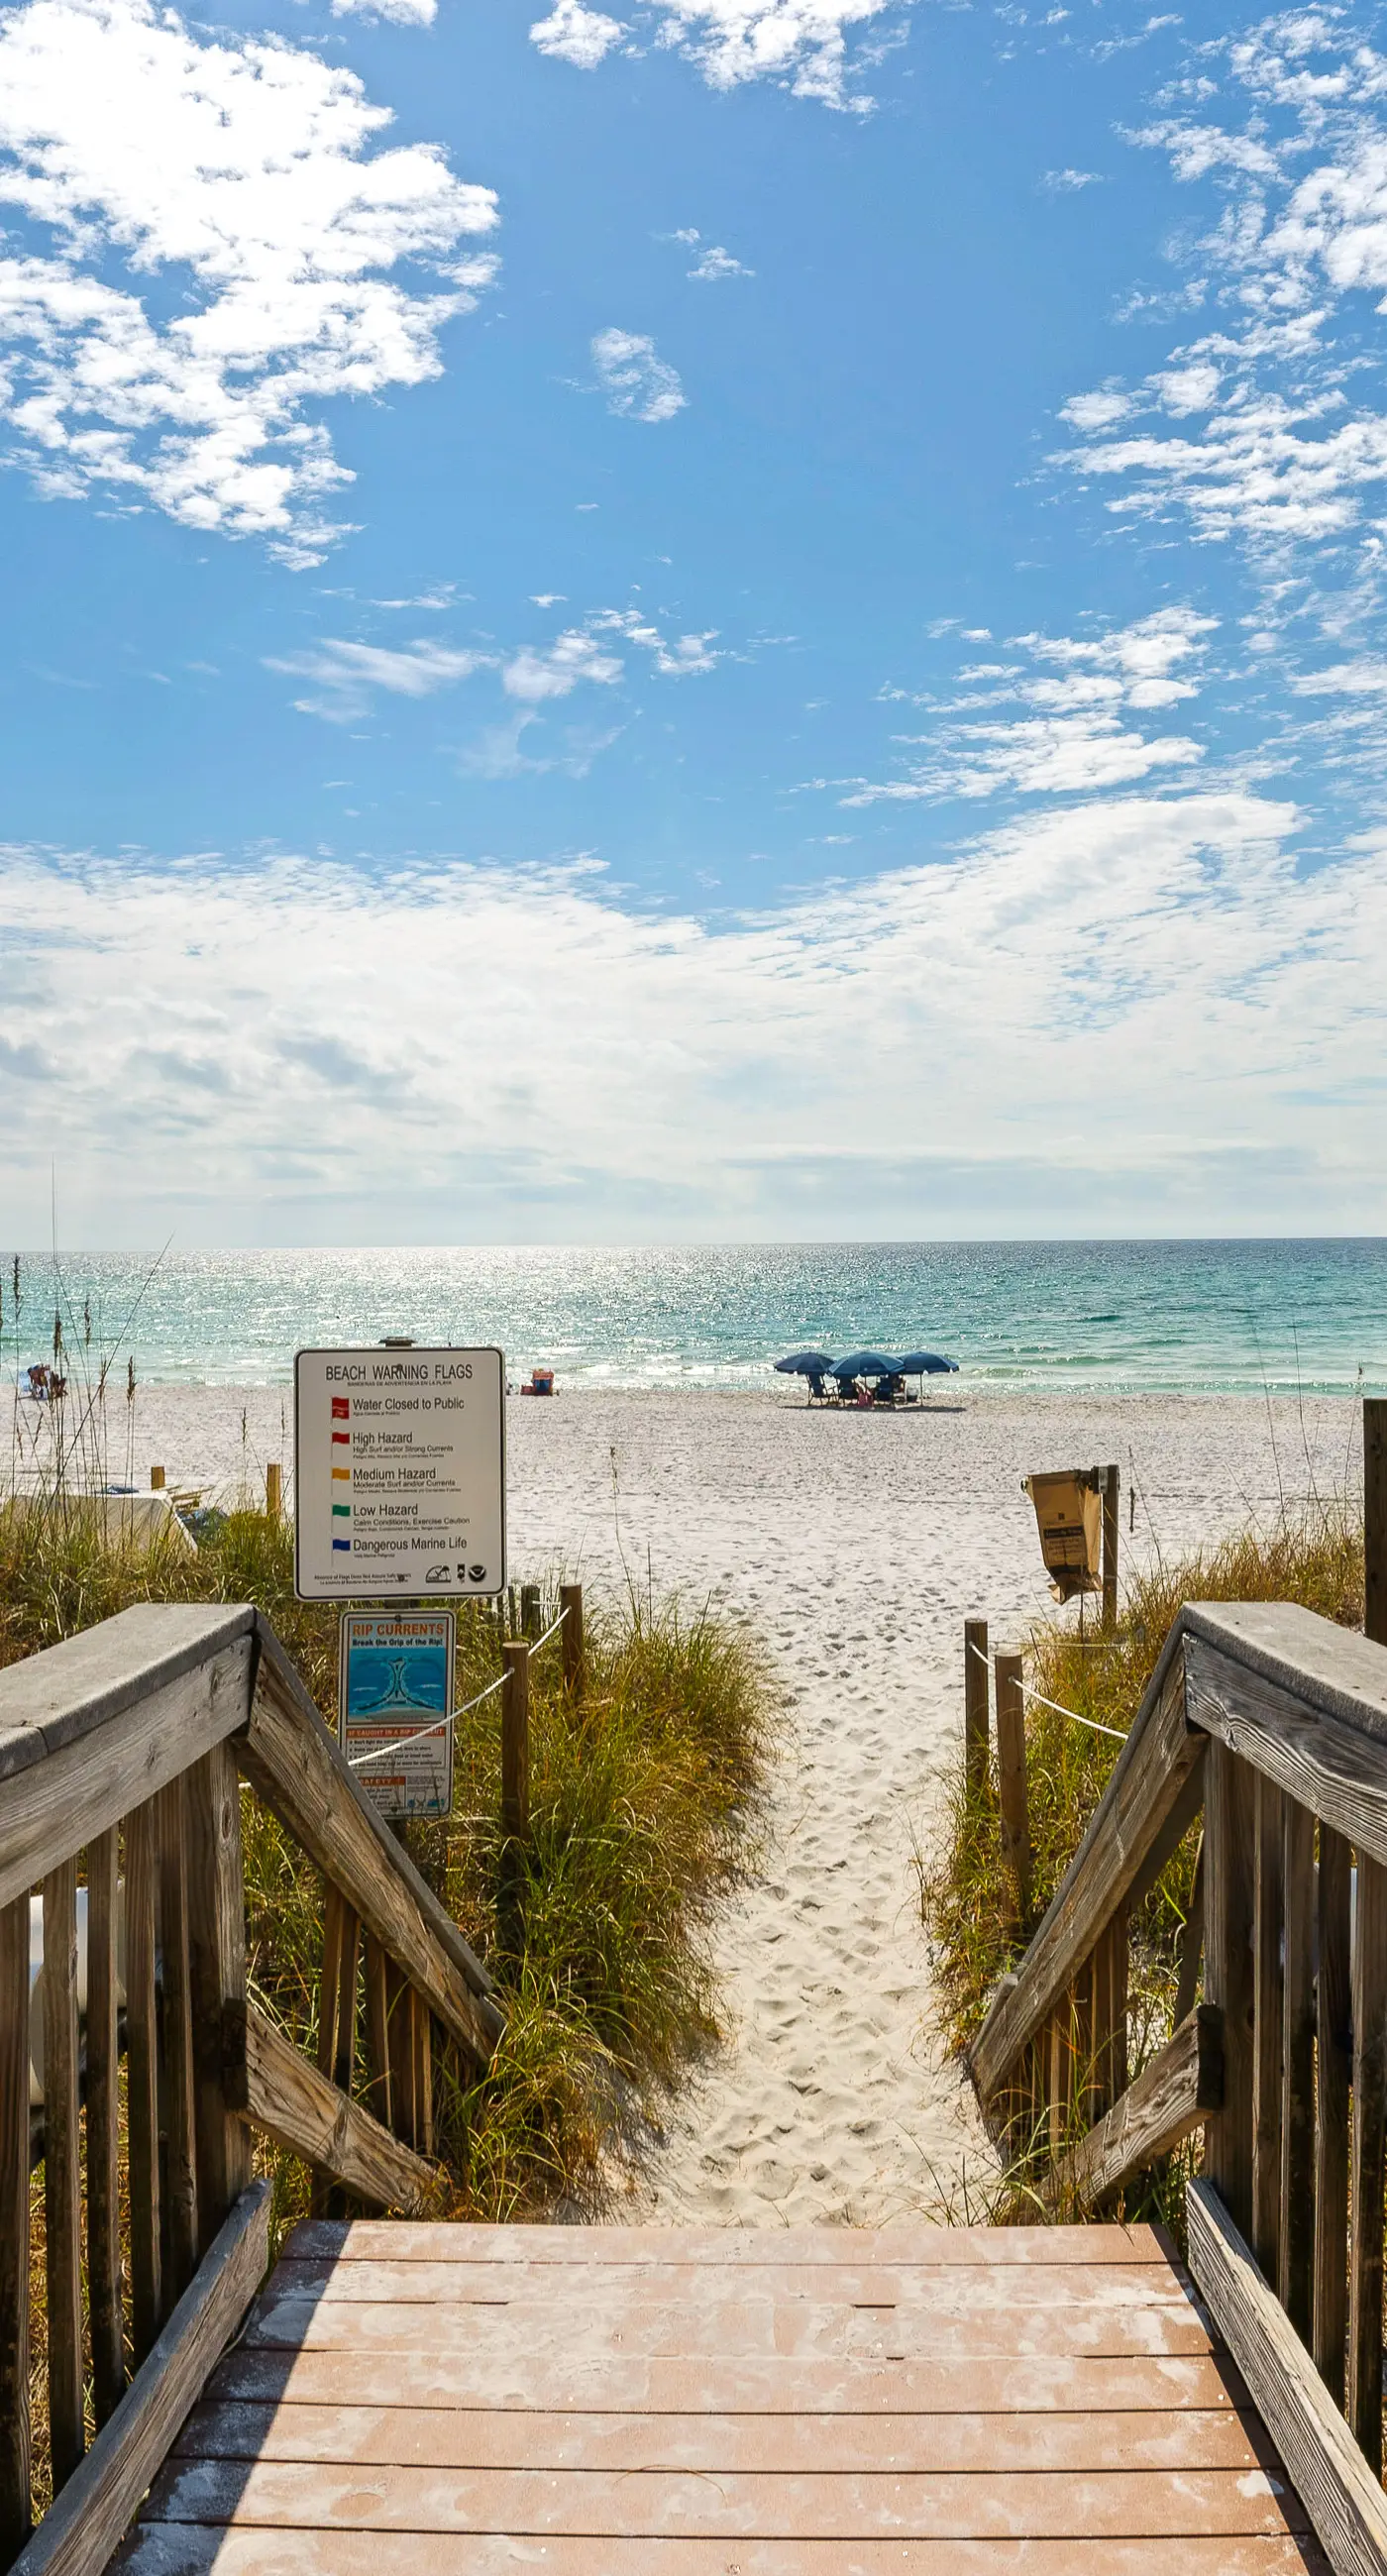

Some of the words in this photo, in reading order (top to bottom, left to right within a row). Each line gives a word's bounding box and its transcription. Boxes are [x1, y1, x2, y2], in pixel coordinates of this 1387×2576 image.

[326, 1365, 367, 1380] BEACH
[373, 1363, 428, 1380] WARNING
[435, 1363, 473, 1379] FLAGS
[353, 1398, 382, 1410] Water
[384, 1397, 419, 1410] Closed
[422, 1398, 432, 1410] to
[434, 1396, 465, 1409] Public
[353, 1432, 375, 1447] High
[377, 1431, 413, 1444] Hazard
[353, 1467, 394, 1480] Medium
[398, 1466, 436, 1479] Hazard
[353, 1504, 376, 1516] Low
[378, 1502, 418, 1516] Hazard
[353, 1538, 409, 1554] Dangerous
[411, 1537, 446, 1550] Marine
[449, 1536, 468, 1549] Life
[353, 1623, 373, 1636] RIP
[377, 1623, 444, 1636] CURRENTS
[389, 1638, 404, 1647] Grip
[429, 1638, 443, 1647] Rip!
